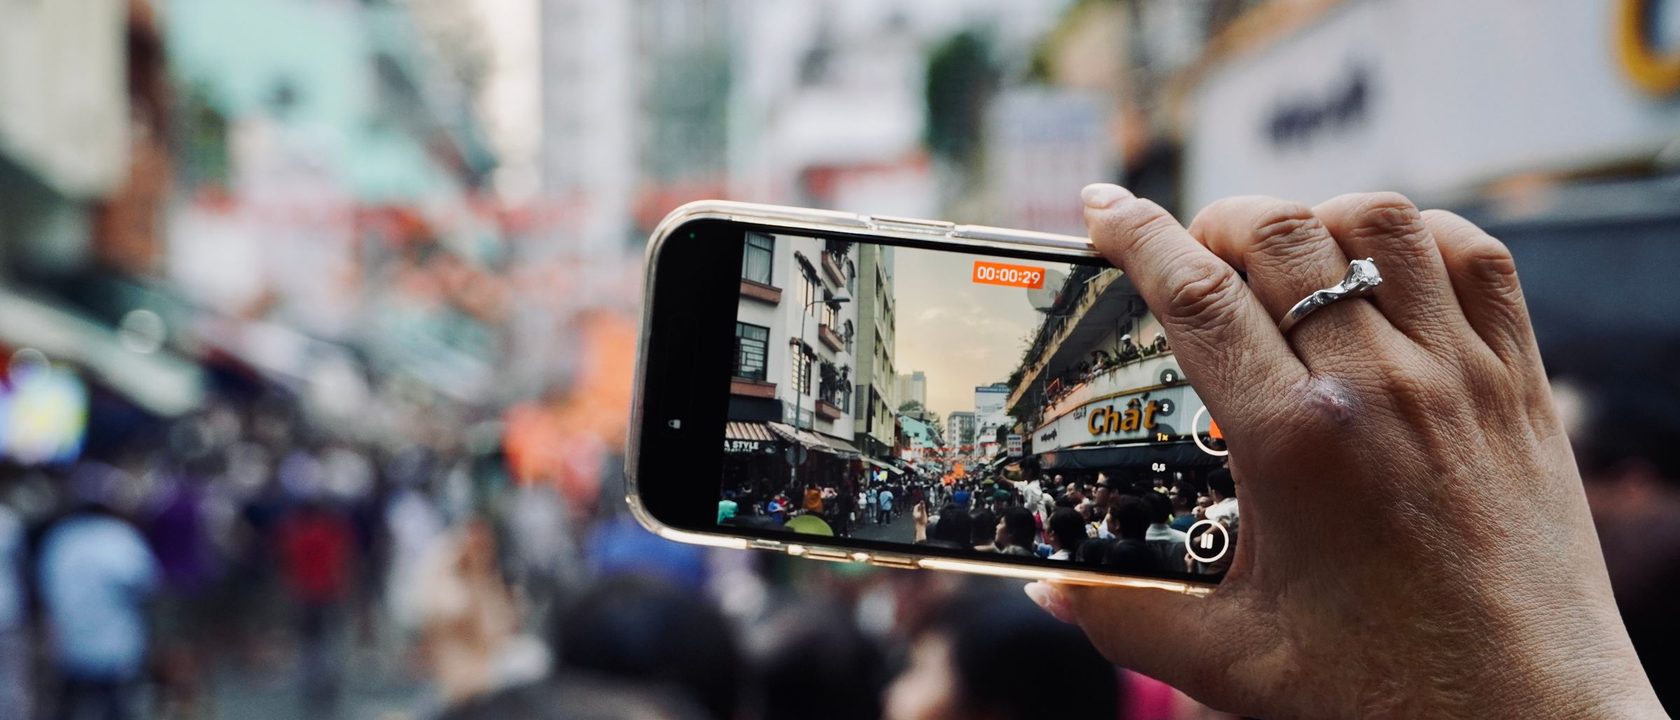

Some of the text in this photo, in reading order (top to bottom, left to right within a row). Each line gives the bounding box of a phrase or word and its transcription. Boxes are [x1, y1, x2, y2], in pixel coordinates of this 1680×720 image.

[977, 266, 1041, 284] 00:00:29
[1165, 373, 1172, 382] 3
[1162, 403, 1169, 412] 2
[1088, 392, 1158, 435] Chất
[1156, 432, 1169, 442] 1x
[732, 440, 759, 450] STYLE
[1151, 462, 1166, 472] 0,5
